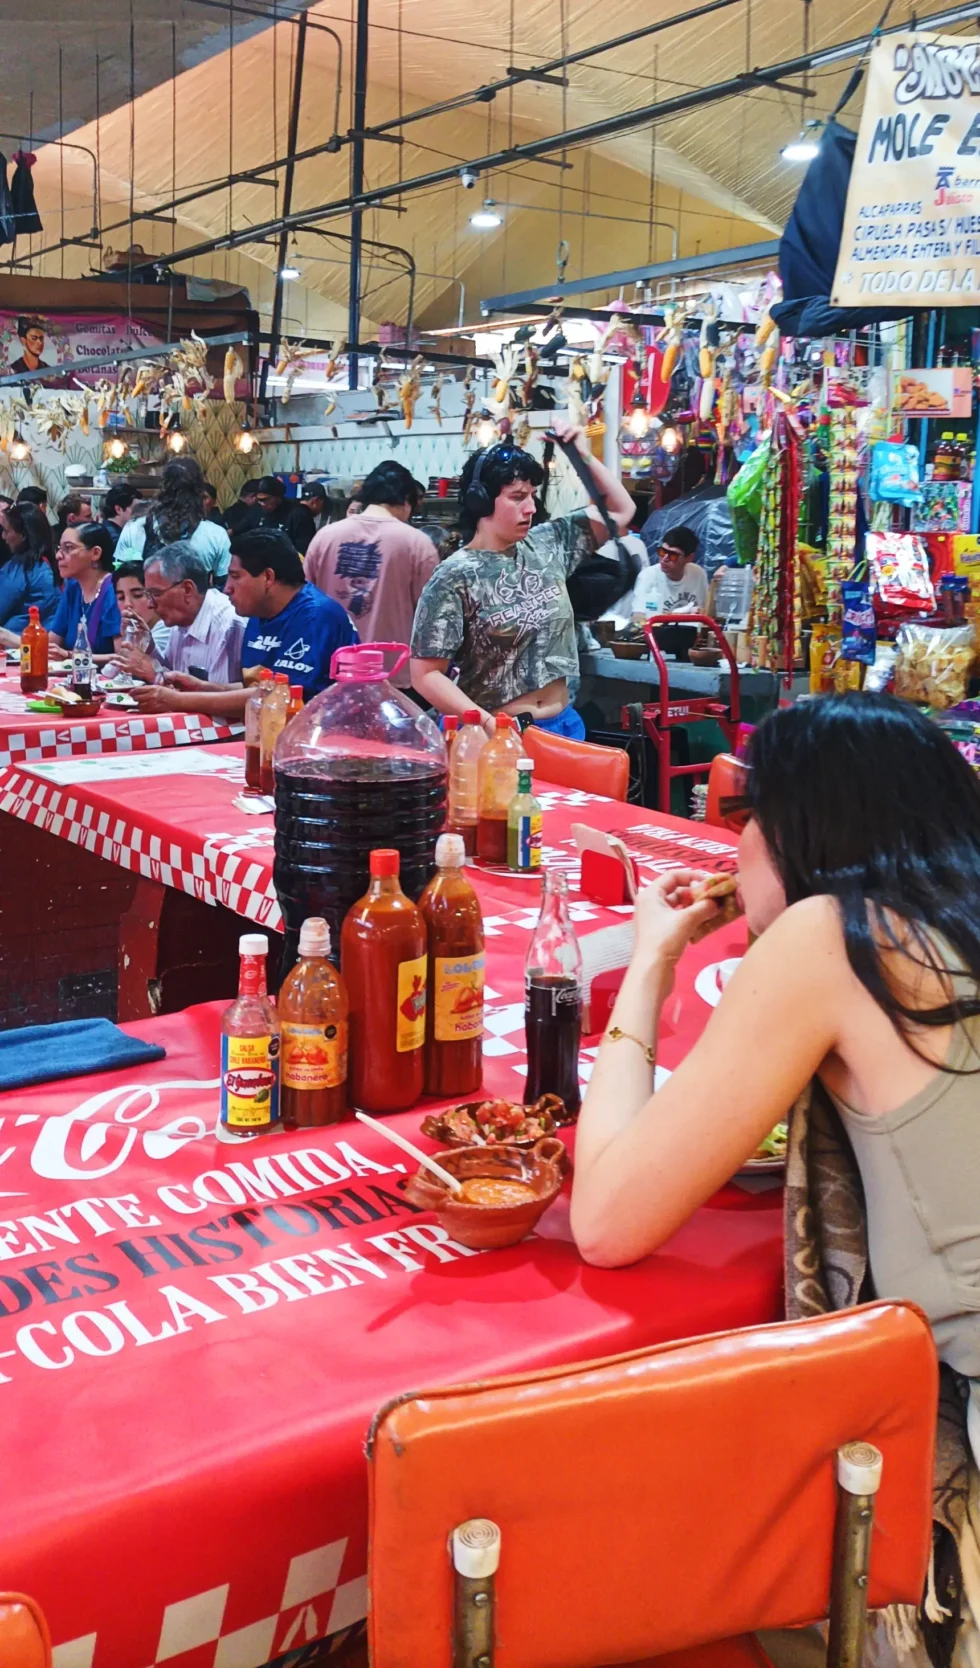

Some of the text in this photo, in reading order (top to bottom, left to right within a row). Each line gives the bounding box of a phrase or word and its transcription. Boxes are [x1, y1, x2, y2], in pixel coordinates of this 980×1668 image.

[868, 111, 980, 163] MOLE E
[859, 201, 922, 218] ALCAPARRAS
[855, 224, 902, 241] CIRUELA
[852, 243, 908, 261] ALMENDRA
[911, 241, 951, 258] ENTERA
[860, 270, 917, 293] TODO
[918, 268, 950, 293] DE
[75, 323, 117, 335] Gomitas
[75, 344, 127, 356] Chocolat
[486, 585, 562, 627] REALTREE
[156, 1140, 408, 1215] COMIDA,
[208, 1242, 386, 1315] BIEN
[365, 1223, 490, 1274] FR
